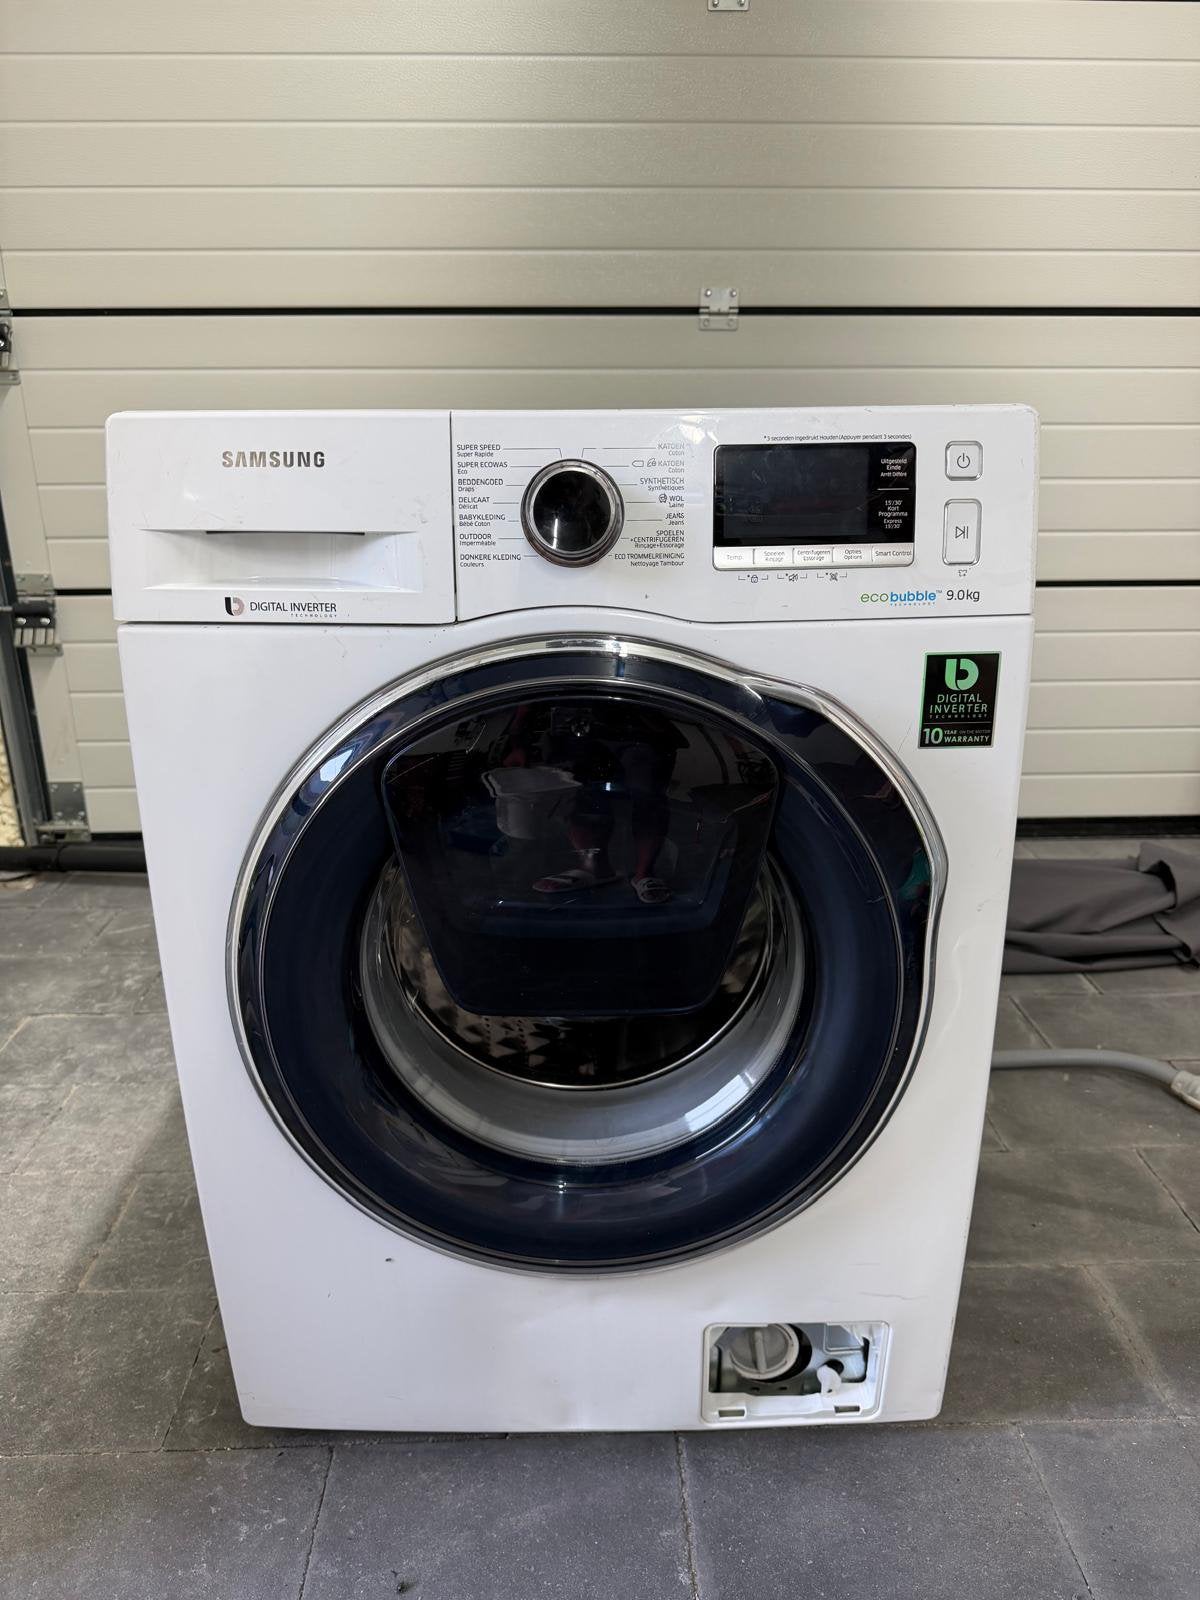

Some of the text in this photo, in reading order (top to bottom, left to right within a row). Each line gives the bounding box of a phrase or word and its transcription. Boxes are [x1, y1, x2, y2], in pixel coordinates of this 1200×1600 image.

[222, 451, 325, 468] SAMSUNG
[250, 602, 337, 612] DIGITAL INVERTER
[937, 694, 982, 703] DIGITAL
[930, 704, 987, 713] INVERTER
[923, 728, 943, 744] 10
